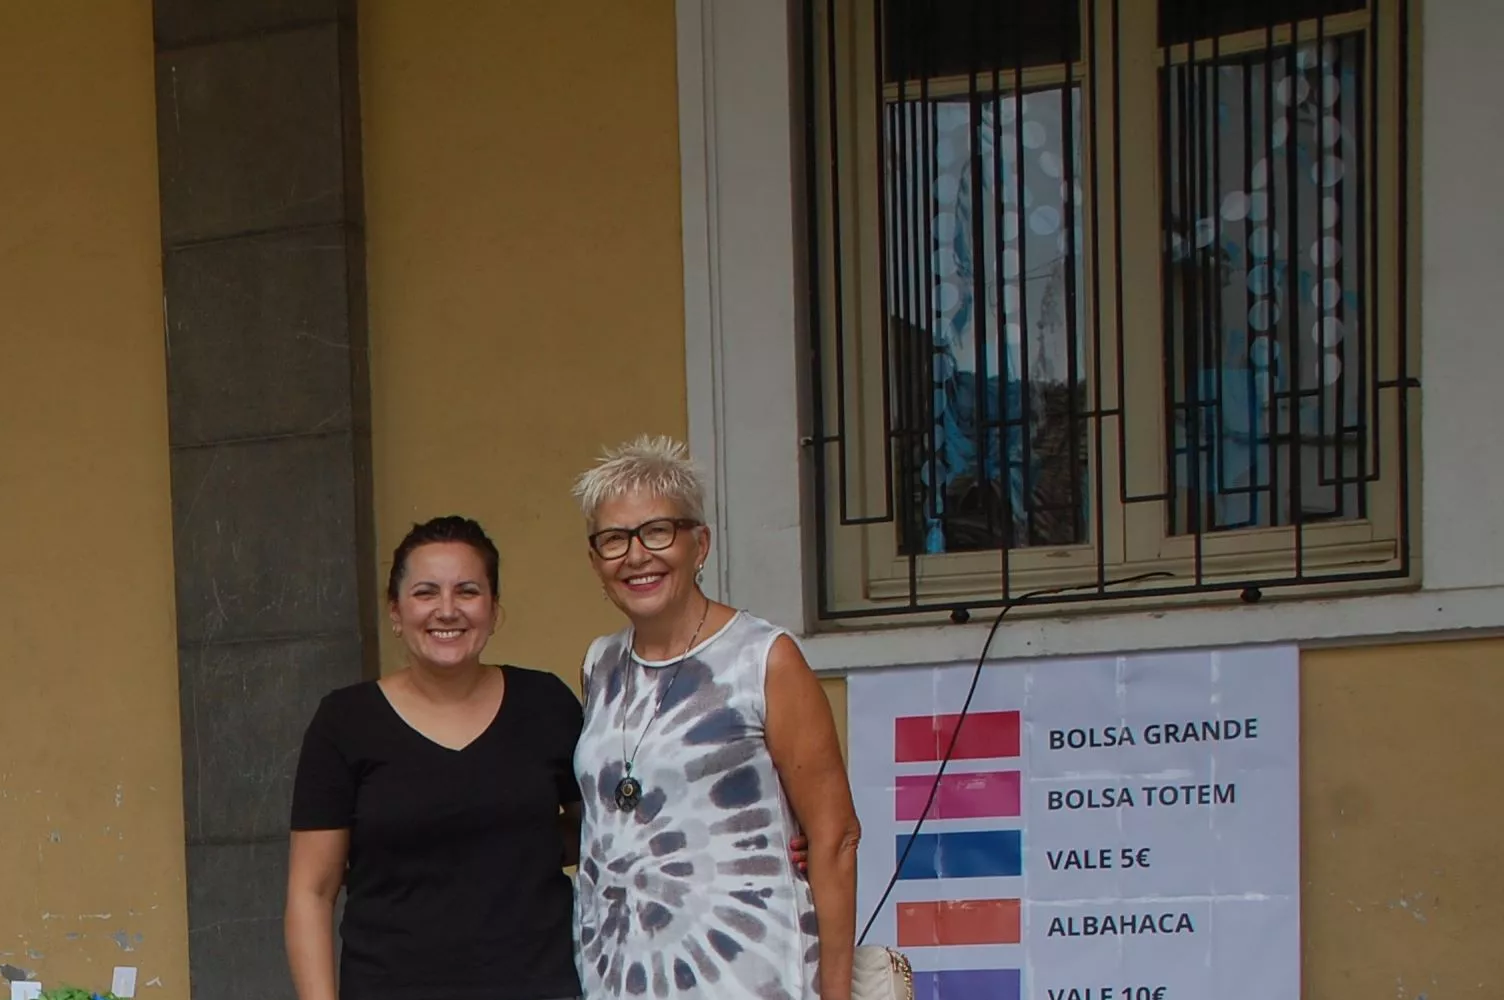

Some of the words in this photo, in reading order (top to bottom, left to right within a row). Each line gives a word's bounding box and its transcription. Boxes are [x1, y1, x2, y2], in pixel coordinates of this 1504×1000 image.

[1048, 727, 1135, 750] BOLSA
[1144, 718, 1258, 746] GRANDE
[1047, 786, 1134, 810] BOLSA
[1142, 783, 1236, 807] TOTEM
[1047, 848, 1112, 870] VALE
[1120, 847, 1151, 869] 5€
[1047, 912, 1194, 937] ALBAHACA
